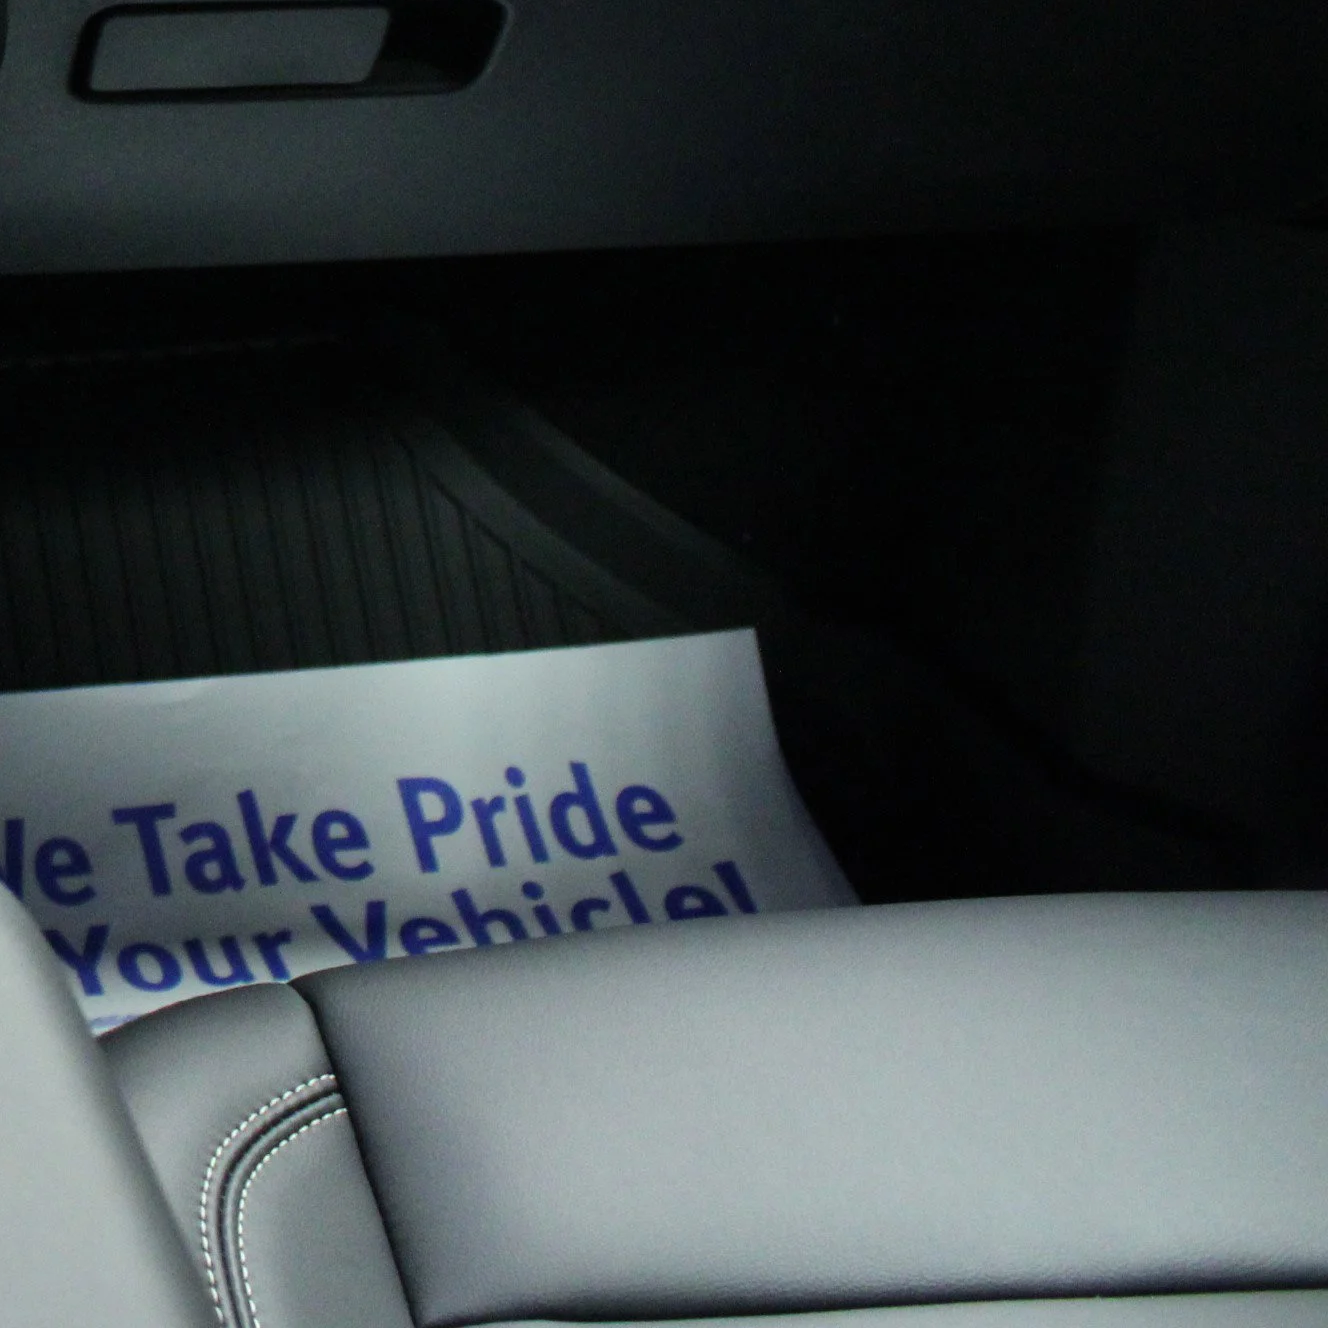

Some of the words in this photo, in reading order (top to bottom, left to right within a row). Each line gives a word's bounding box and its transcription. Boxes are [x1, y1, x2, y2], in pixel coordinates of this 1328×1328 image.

[112, 789, 376, 897] Take
[397, 761, 684, 874] Pride
[44, 924, 293, 997] Your
